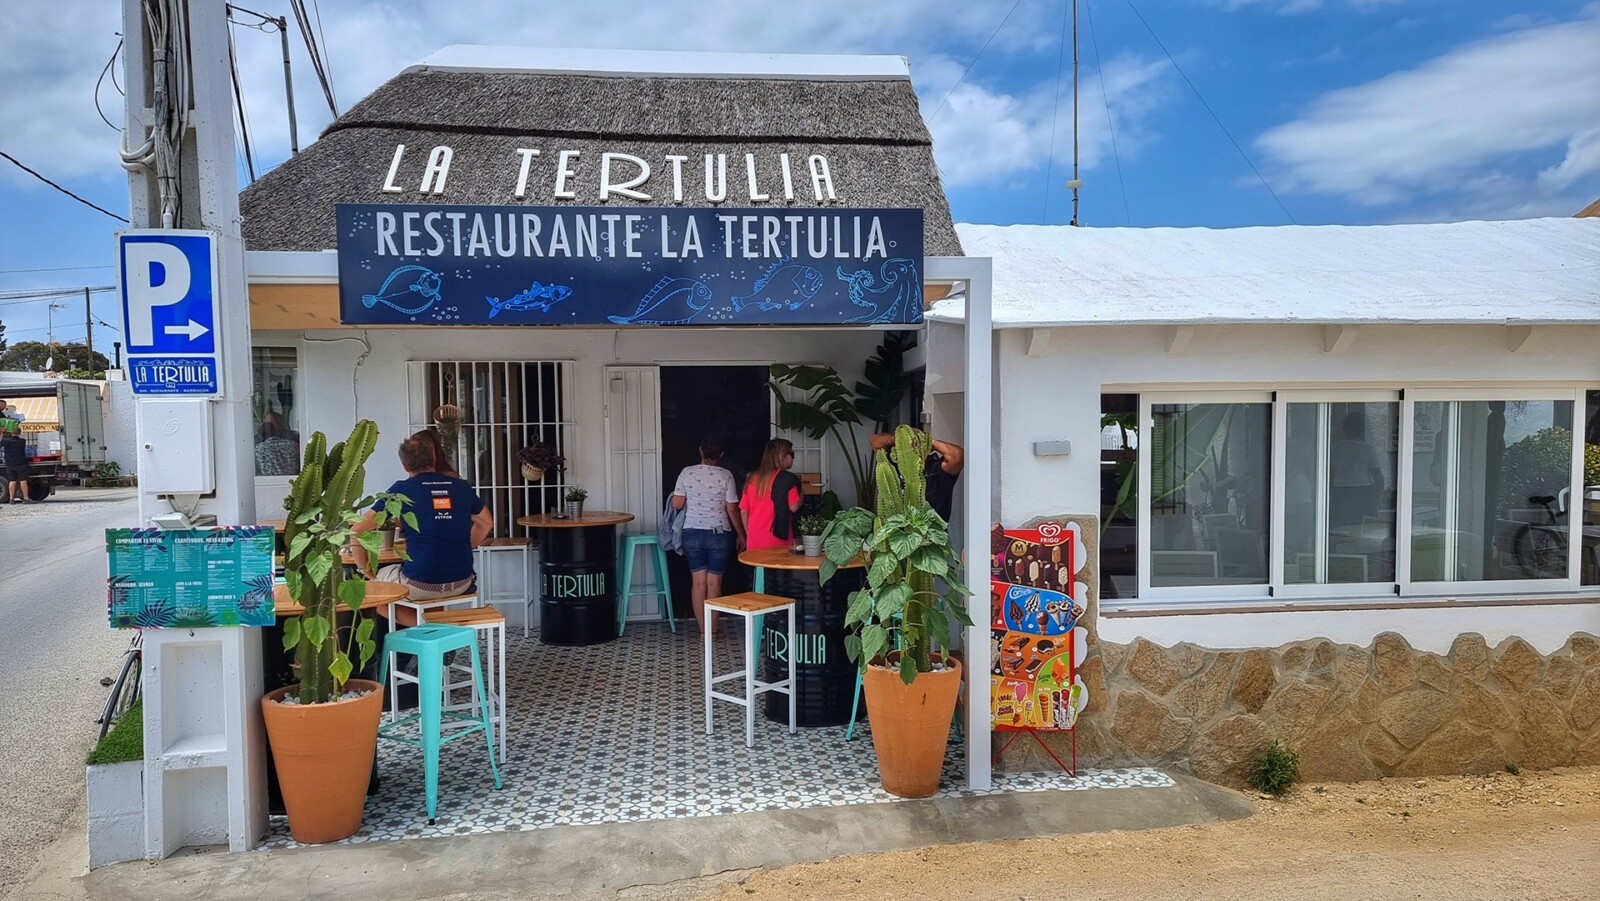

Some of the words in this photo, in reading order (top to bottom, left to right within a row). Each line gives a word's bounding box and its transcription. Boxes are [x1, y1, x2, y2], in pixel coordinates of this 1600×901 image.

[382, 144, 454, 196] LA
[515, 147, 837, 203] TERTULIA
[376, 211, 643, 258] RESTAURANTE
[661, 214, 704, 259] LA
[718, 215, 888, 259] TERTULIA
[124, 242, 192, 347] P
[136, 366, 147, 383] LA
[152, 366, 209, 383] TERTULIA
[541, 573, 548, 596] LA
[551, 572, 605, 598] TERTULIA
[766, 627, 826, 664] TERULIA
